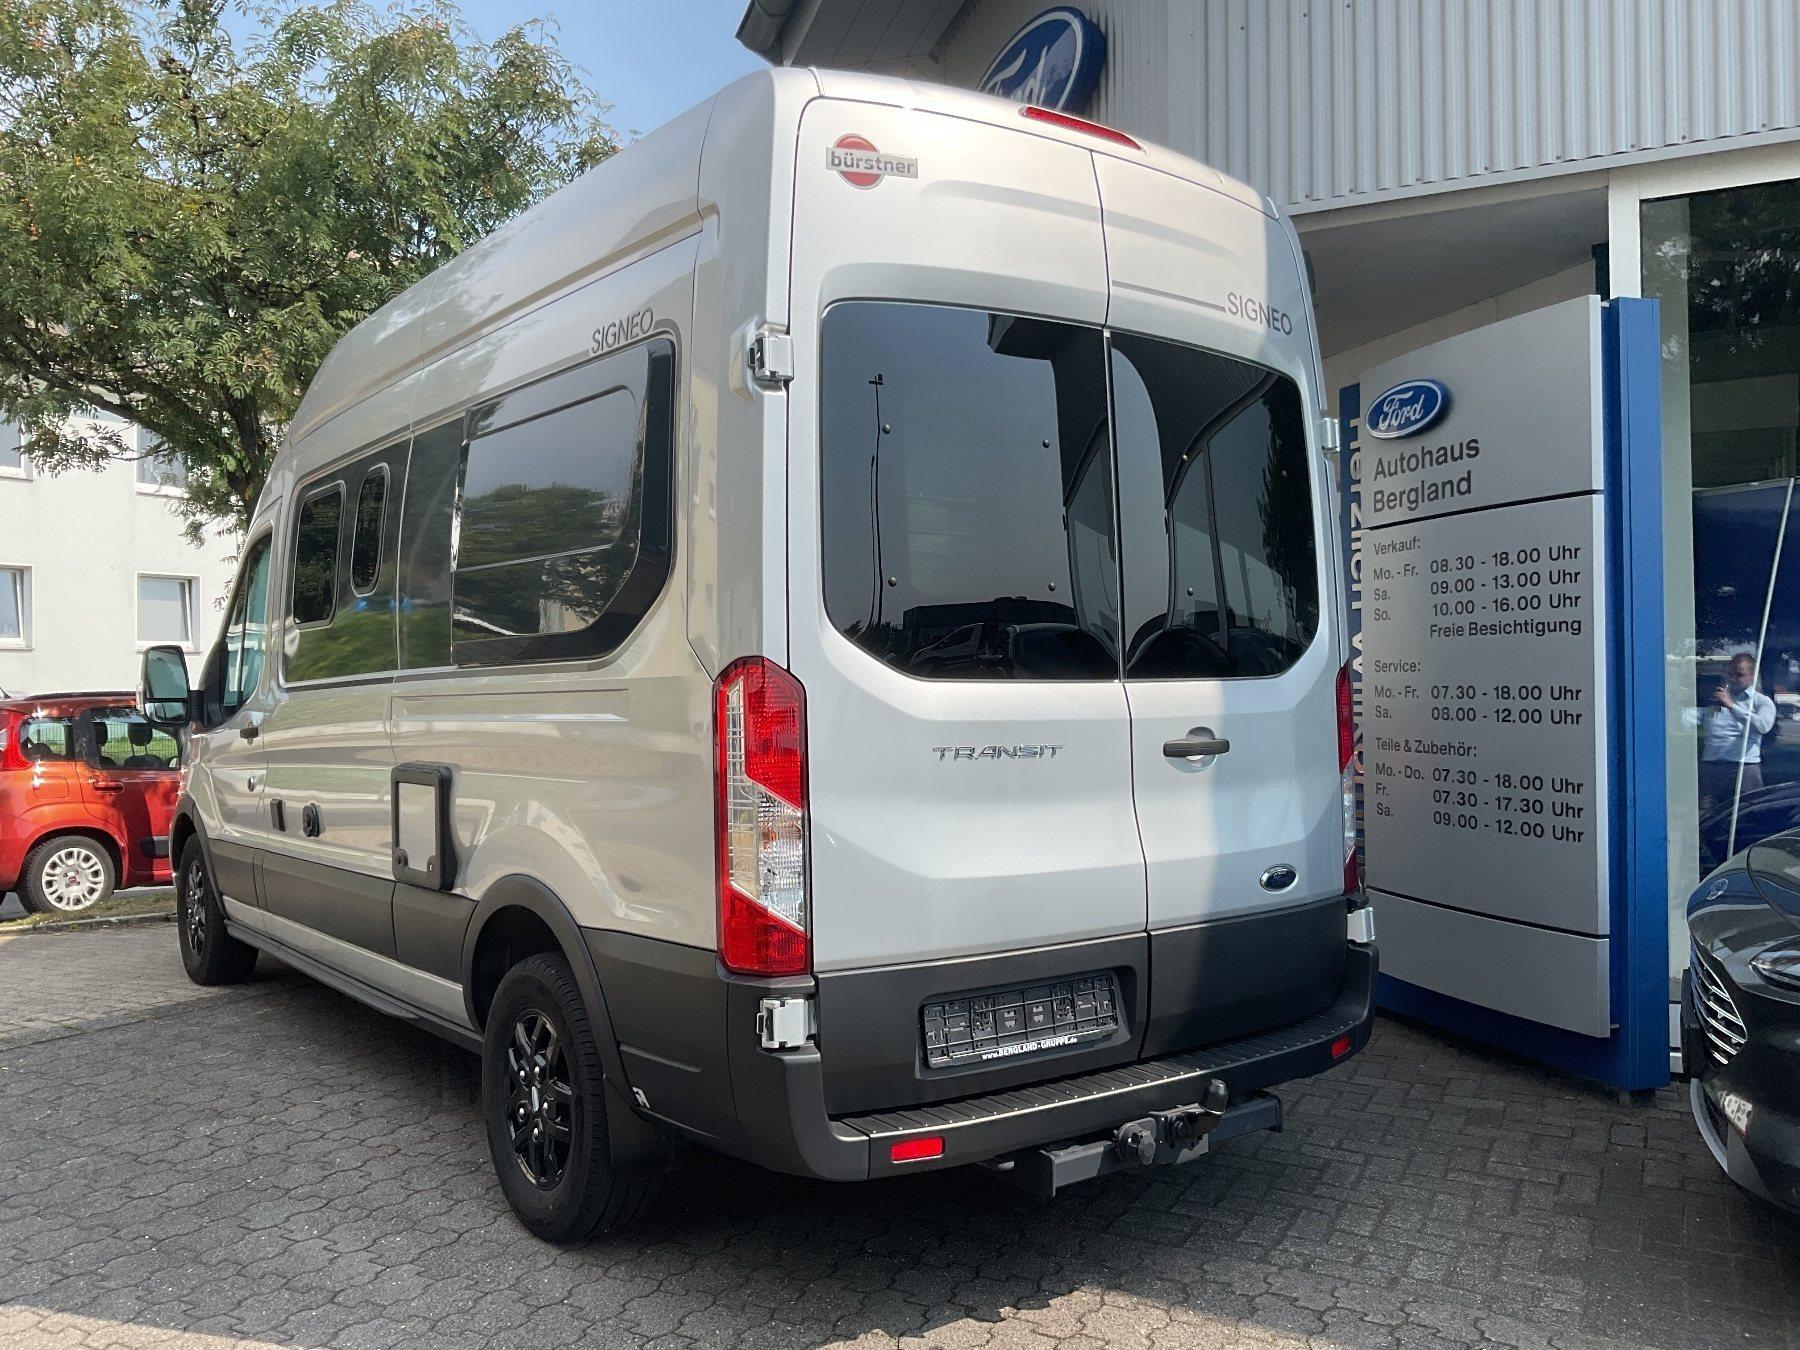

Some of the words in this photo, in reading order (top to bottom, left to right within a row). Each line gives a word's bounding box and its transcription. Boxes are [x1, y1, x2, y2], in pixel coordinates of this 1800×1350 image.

[830, 151, 916, 174] bürstner
[1227, 291, 1293, 336] SIGNEO
[591, 306, 654, 354] SIGNEO
[1378, 390, 1425, 430] Ford
[1373, 438, 1480, 482] Autohaus
[1373, 469, 1472, 513] Bergland
[1373, 536, 1421, 556] Verkauf:
[1373, 567, 1394, 581] Mo.
[1403, 563, 1418, 577] Fr.
[1430, 555, 1475, 573] 08.30
[1491, 547, 1541, 567] 18.00
[1548, 545, 1581, 561] Uhr
[1373, 588, 1391, 601] Sa.
[1430, 577, 1475, 595] 09.00
[1492, 571, 1541, 589] 13.00
[1548, 569, 1581, 585] Uhr
[1373, 608, 1391, 621] So.
[1432, 599, 1475, 617] 10.00
[1492, 594, 1542, 612] 16.00
[1549, 593, 1581, 609] Uhr
[1429, 623, 1464, 638] Freie
[1468, 619, 1582, 636] Besichtigung
[1374, 659, 1421, 673] Service:
[1374, 685, 1395, 698] Mo.
[1404, 685, 1419, 699] Fr.
[1430, 685, 1476, 700] 07.30
[1493, 685, 1542, 701] 18.00
[1550, 685, 1582, 701] Uhr
[1374, 705, 1392, 719] Sa.
[1431, 706, 1477, 722] 08.00
[1494, 708, 1543, 724] 12.00
[1550, 709, 1583, 725] Uhr
[932, 744, 1064, 761] TRANSIT
[1375, 737, 1401, 752] Teile
[1403, 738, 1412, 752] &
[1414, 739, 1478, 757] Zubehör:
[1375, 762, 1396, 777] Mo.
[1404, 765, 1424, 780] Do.
[1432, 767, 1477, 786] 07.30
[1494, 773, 1543, 791] 18.00
[1551, 777, 1584, 795] Uhr
[1375, 782, 1389, 797] Fr.
[1432, 789, 1478, 808] 07.30
[1495, 796, 1544, 815] 17.30
[1552, 801, 1584, 819] Uhr
[1376, 802, 1394, 817] Sa.
[1433, 810, 1478, 830] 09.00
[1495, 819, 1545, 839] 12.00
[1552, 825, 1585, 843] Uhr
